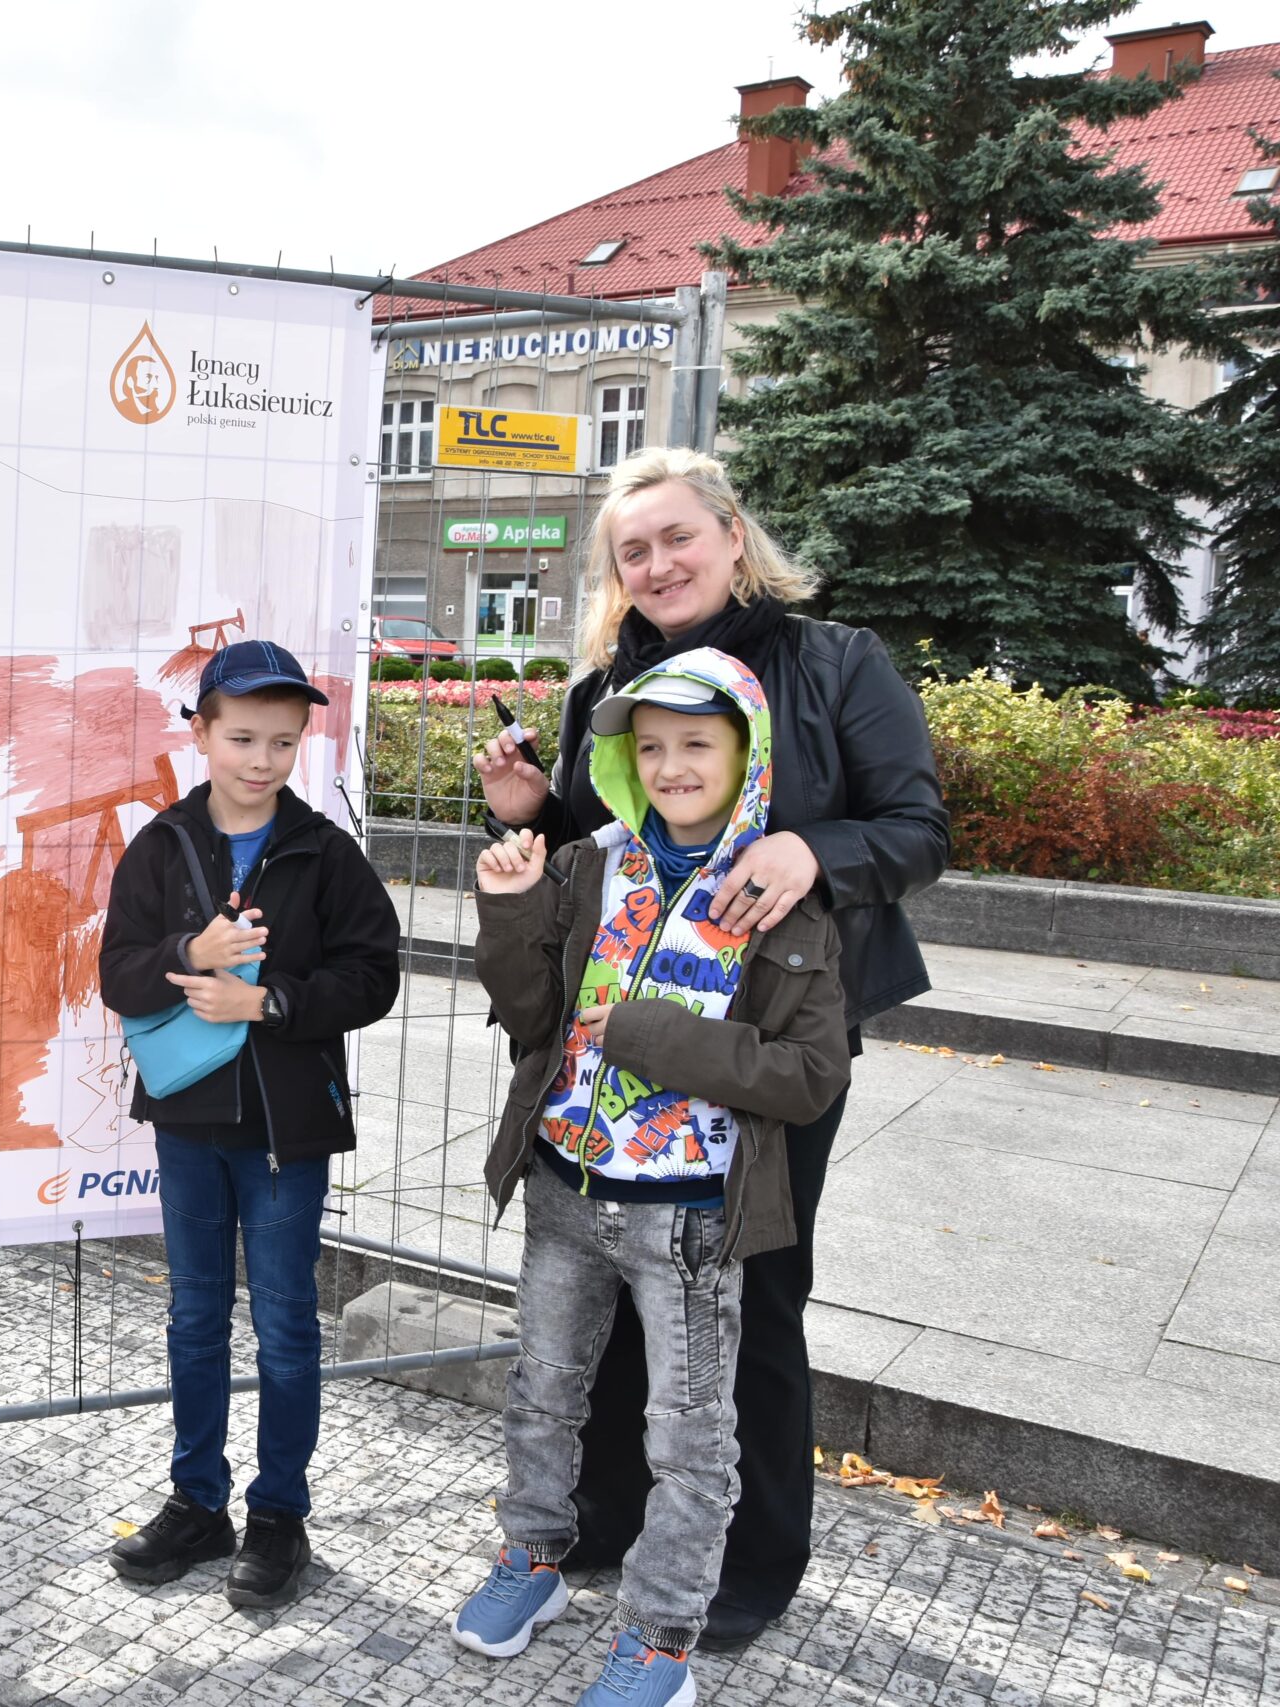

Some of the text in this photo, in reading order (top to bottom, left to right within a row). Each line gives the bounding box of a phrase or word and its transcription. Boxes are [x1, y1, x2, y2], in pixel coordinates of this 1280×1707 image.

[423, 323, 671, 367] NIERUCHOMOS
[190, 350, 260, 385] Ignacy
[187, 379, 333, 418] Łukasiewicz
[187, 413, 257, 429] polski geniusz
[459, 411, 507, 438] TLC
[503, 524, 560, 543] Apteka
